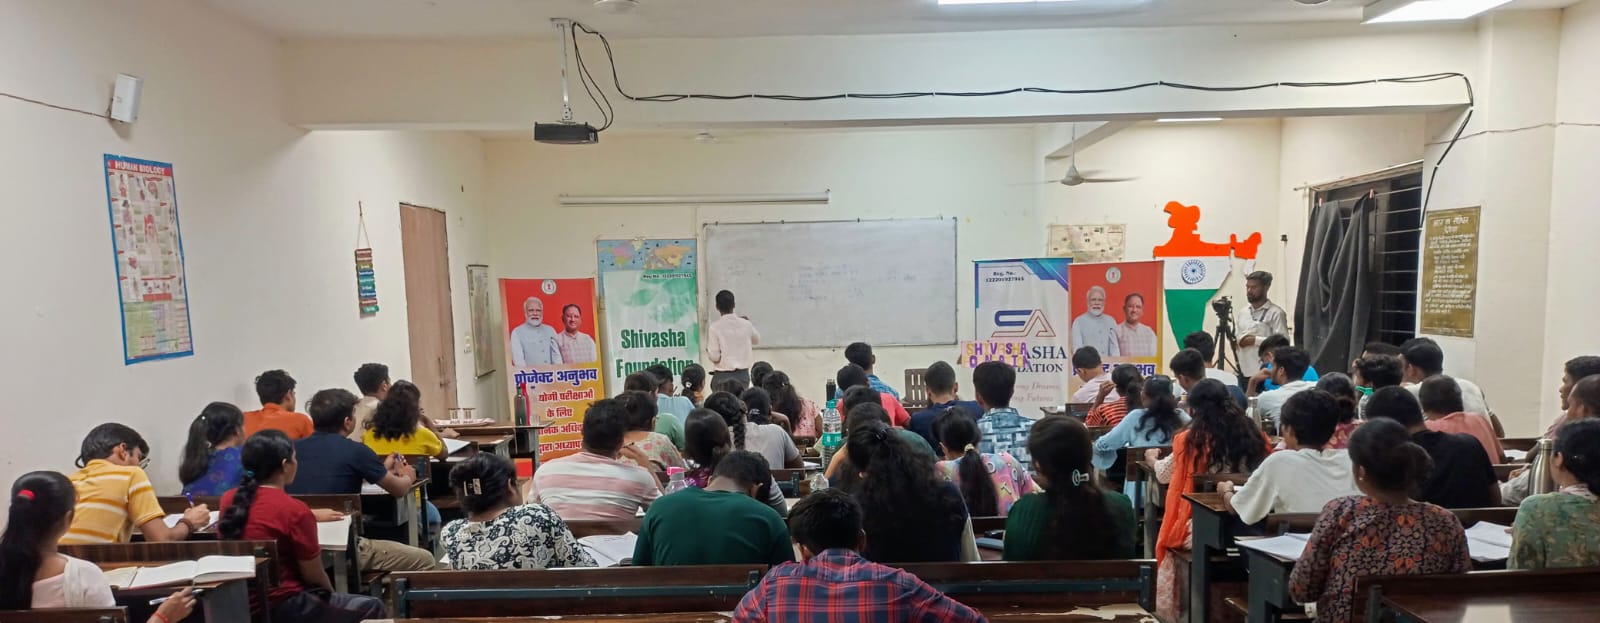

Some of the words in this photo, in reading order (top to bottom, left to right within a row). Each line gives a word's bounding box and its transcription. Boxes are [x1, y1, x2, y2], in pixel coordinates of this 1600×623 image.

[115, 160, 138, 171] HUMAN
[139, 165, 165, 175] BIOLOGY
[621, 328, 686, 348] Shivasha
[966, 342, 1027, 355] SHIVASHA
[557, 369, 597, 386] अनुभव
[547, 408, 554, 417] के
[556, 407, 573, 417] लिए
